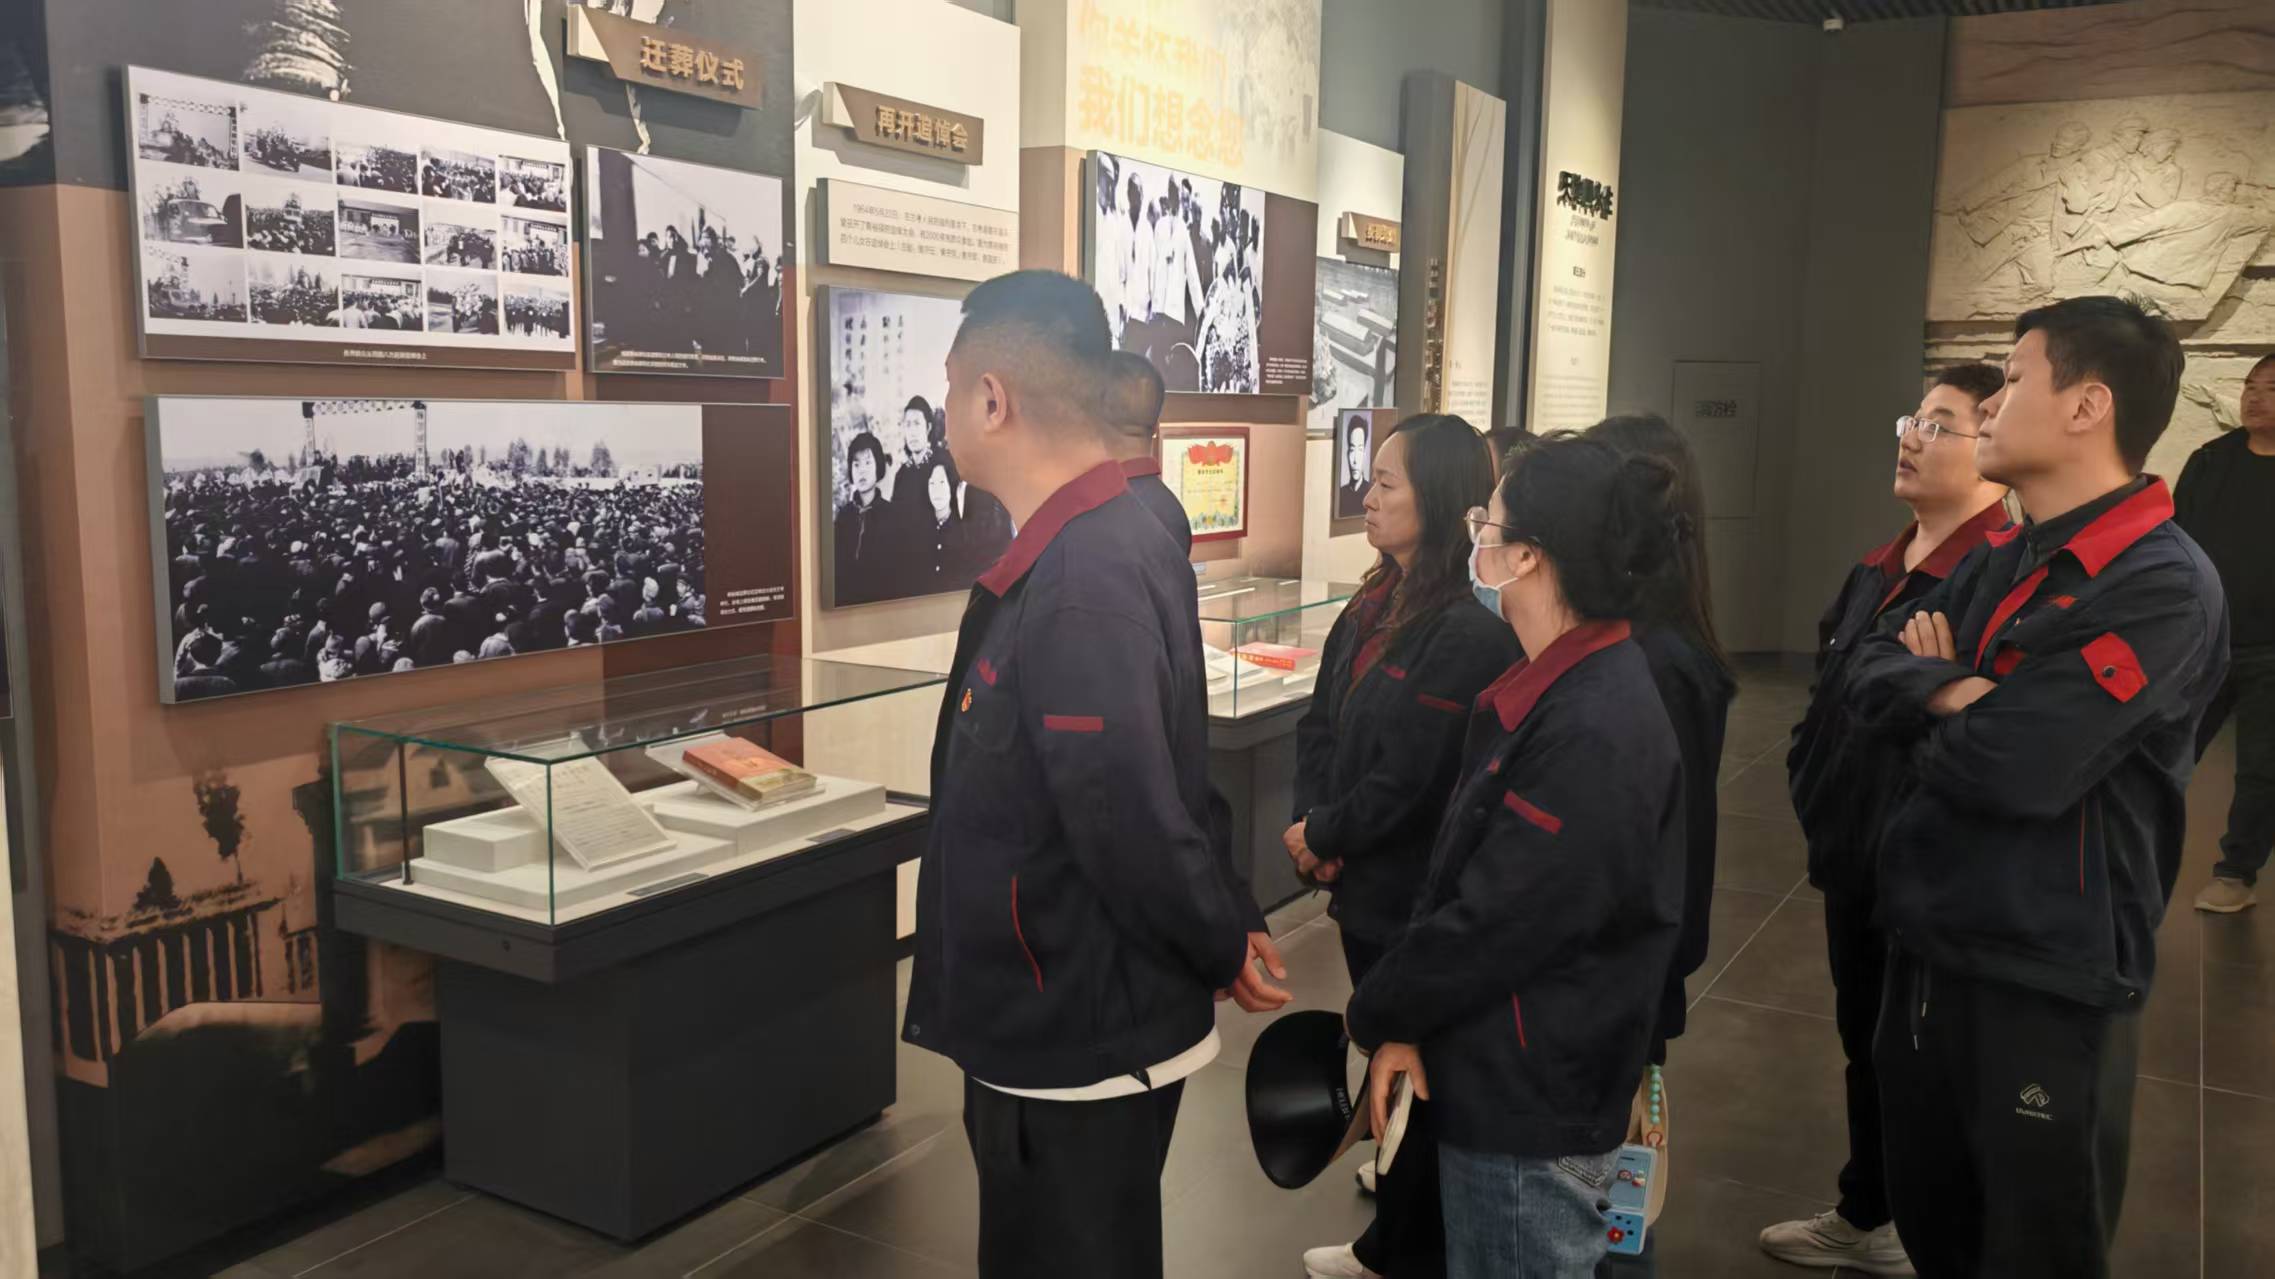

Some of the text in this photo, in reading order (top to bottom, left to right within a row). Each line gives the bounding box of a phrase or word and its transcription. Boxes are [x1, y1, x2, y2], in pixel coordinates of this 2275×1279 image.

[640, 36, 745, 91] 迁葬仪式
[876, 105, 969, 151] 再开追悼会
